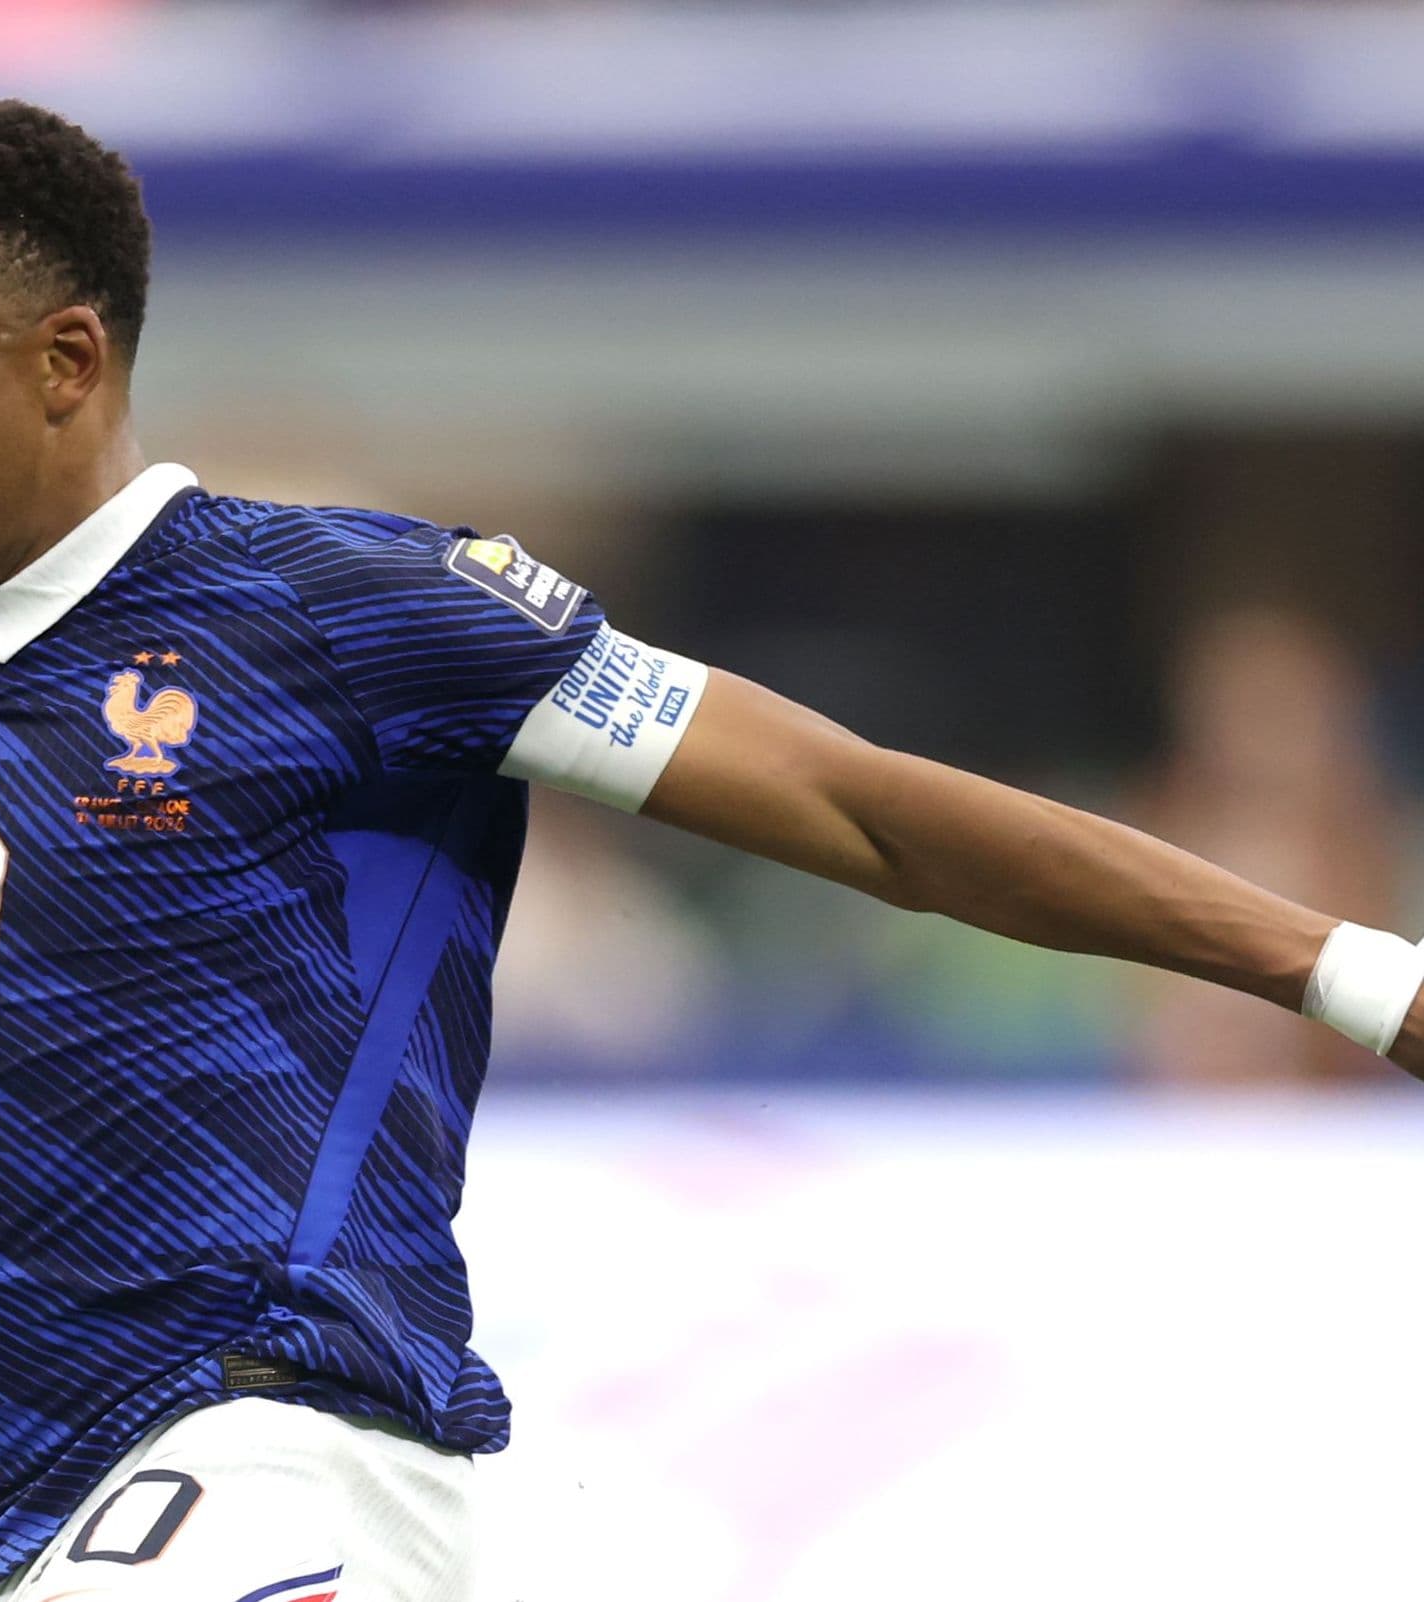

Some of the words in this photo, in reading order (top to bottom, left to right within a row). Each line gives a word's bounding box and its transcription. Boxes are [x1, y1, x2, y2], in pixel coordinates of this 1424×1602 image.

[574, 636, 639, 730] UNITES
[657, 687, 688, 726] FIFA
[609, 709, 644, 748] the
[48, 1469, 205, 1572] 0
